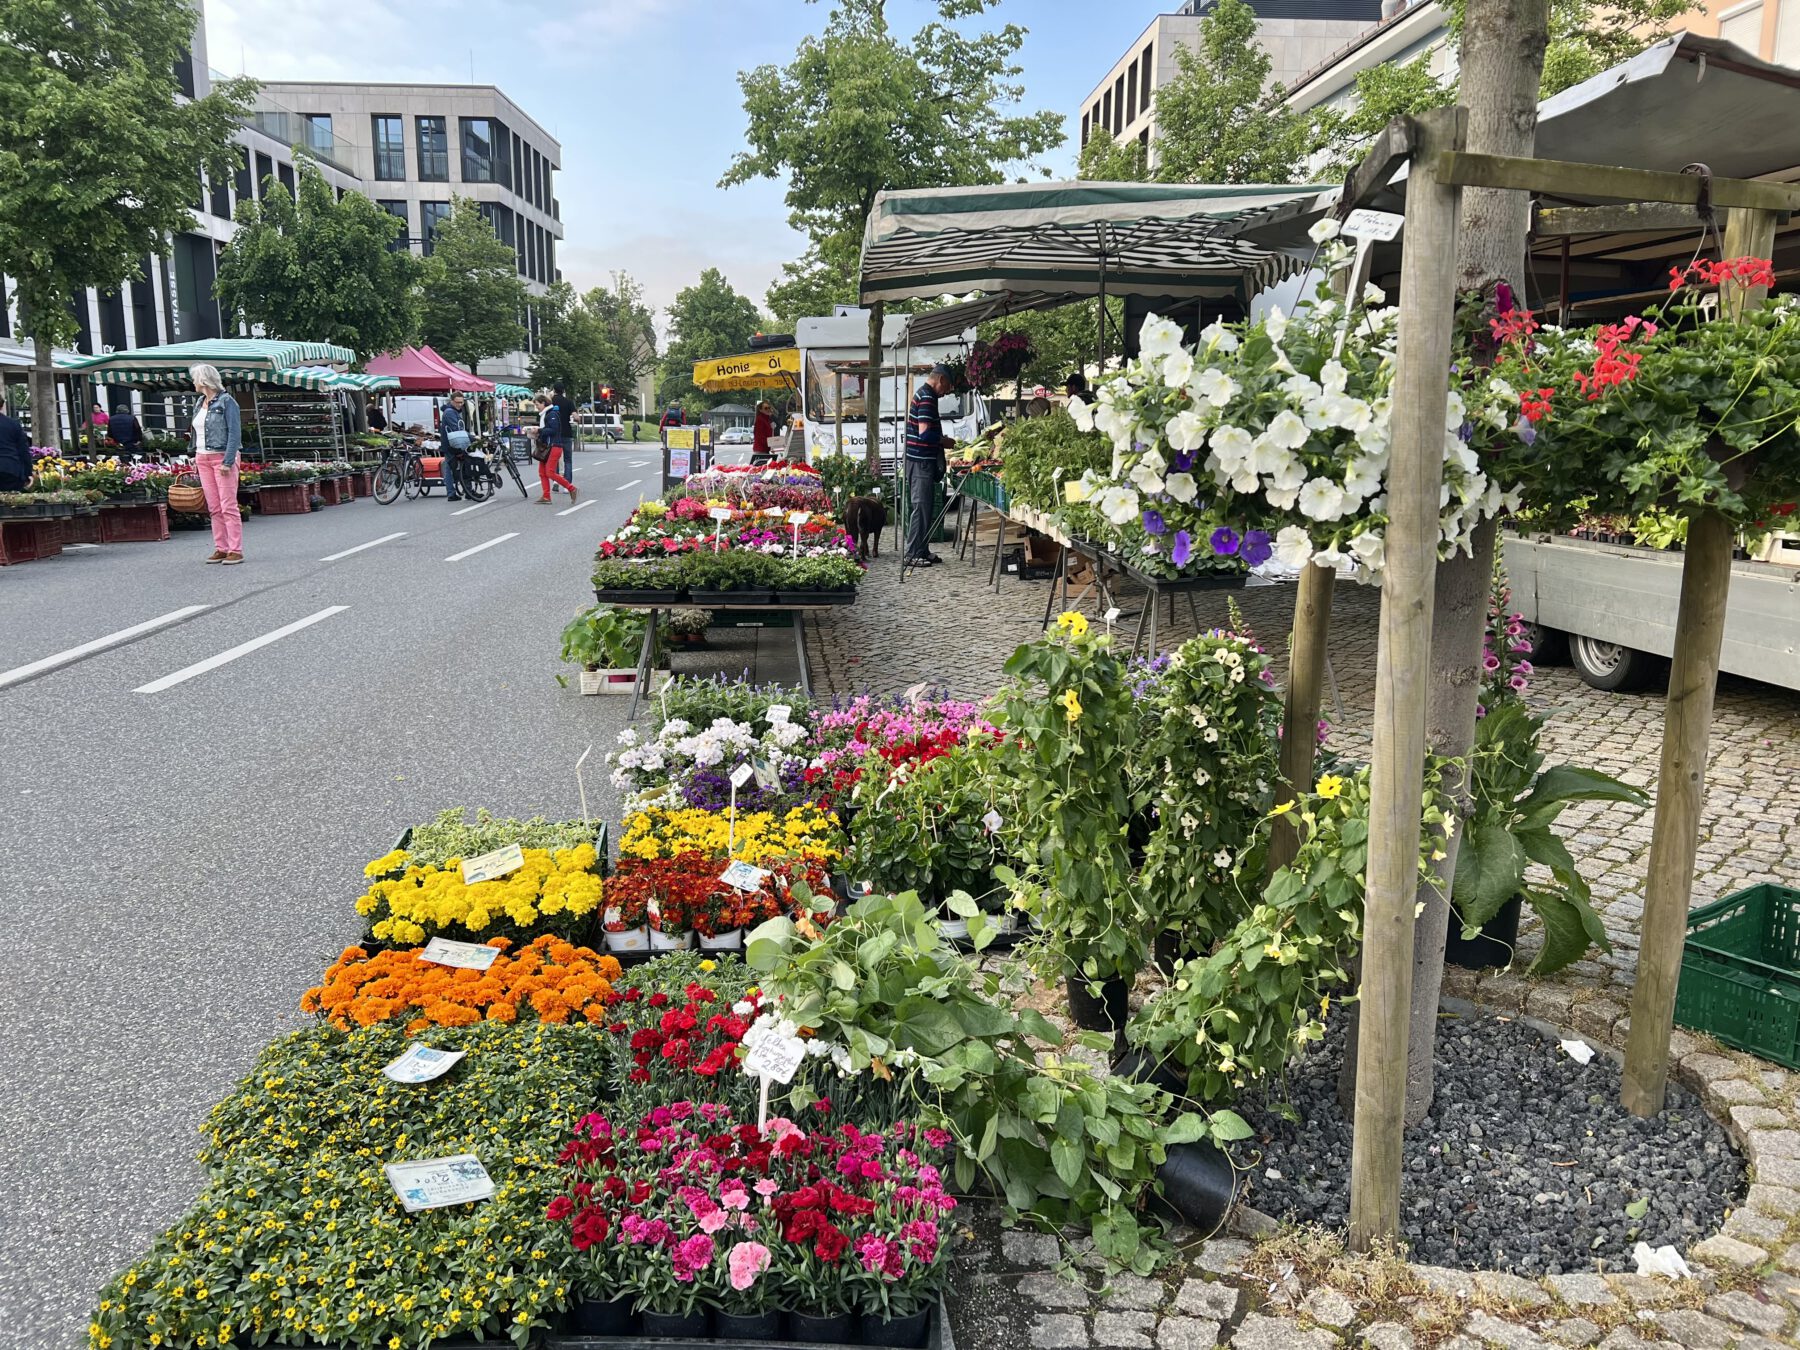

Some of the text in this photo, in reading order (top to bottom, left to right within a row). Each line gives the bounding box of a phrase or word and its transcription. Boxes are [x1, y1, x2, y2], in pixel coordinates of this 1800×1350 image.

[169, 271, 180, 336] STRASSE
[716, 355, 781, 376] Honig Öl
